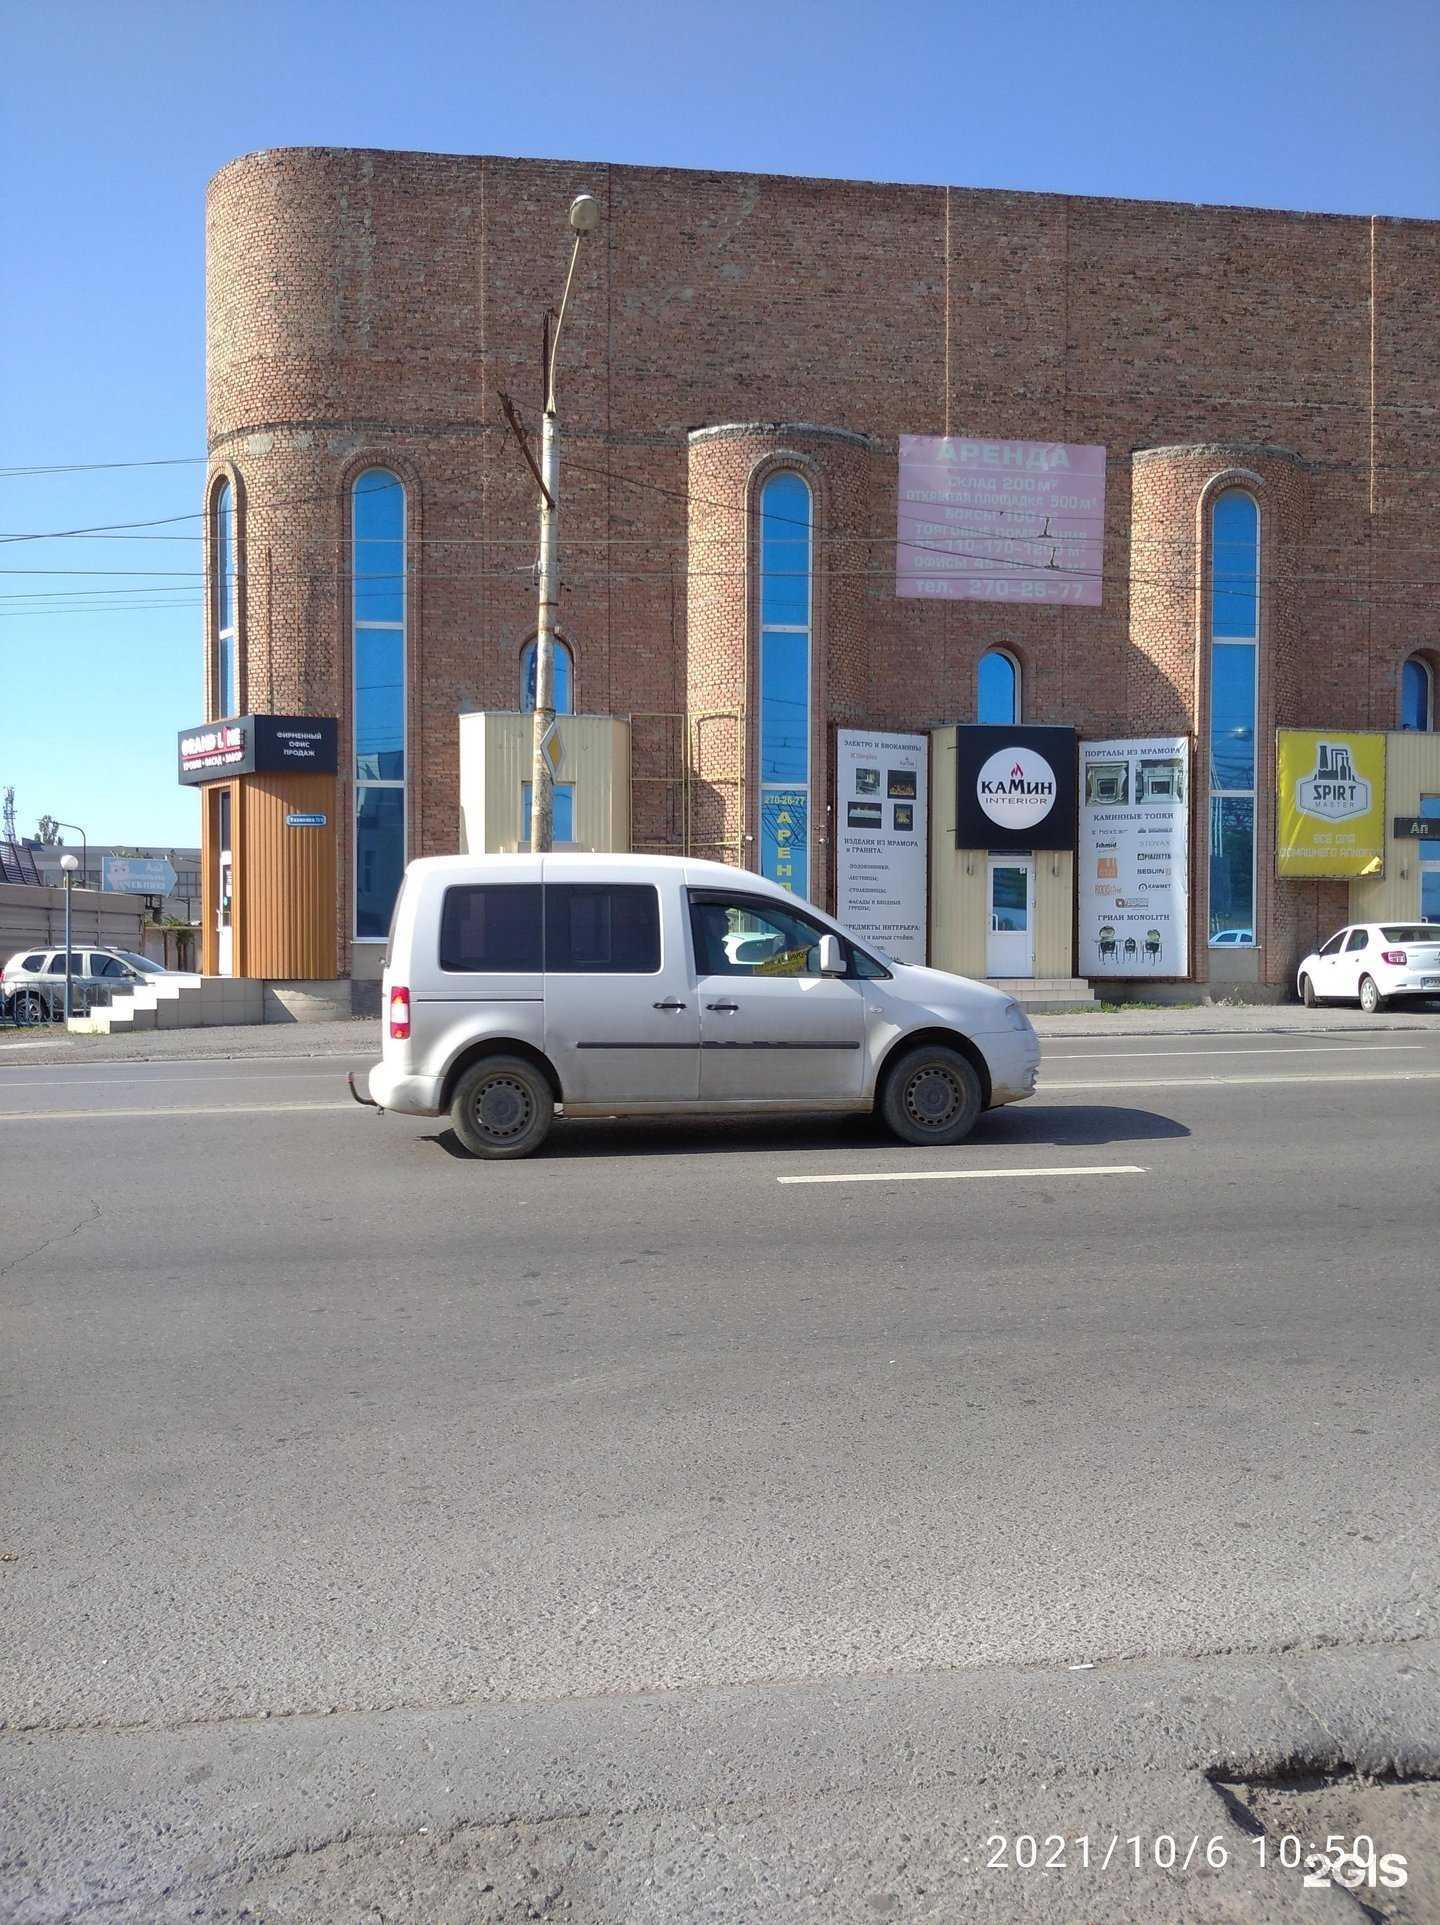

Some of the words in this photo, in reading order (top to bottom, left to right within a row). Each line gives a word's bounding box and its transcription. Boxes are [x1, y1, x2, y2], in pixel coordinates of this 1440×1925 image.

[936, 442, 1071, 470] АРЕНДА
[1002, 478, 1034, 490] 200
[276, 732, 322, 740] ФИРМЕННЫЙ
[844, 740, 873, 749] ЭЛЕКТРО
[283, 749, 315, 757] ПРОДАЖ
[1085, 749, 1124, 757] ПОРТАЛЫ
[1141, 747, 1181, 755] МРАМОРА
[981, 779, 1053, 795] КАМИН
[1313, 785, 1356, 800] SPIRT
[985, 797, 1048, 805] INTERIOR
[1094, 814, 1142, 822] КАМИННЫЕ
[1144, 812, 1174, 820] ТОПКИ
[844, 838, 875, 846] ИЗДЕЛИЯ
[887, 840, 918, 848] МРАМОРА
[1127, 913, 1170, 921] MONOLITH
